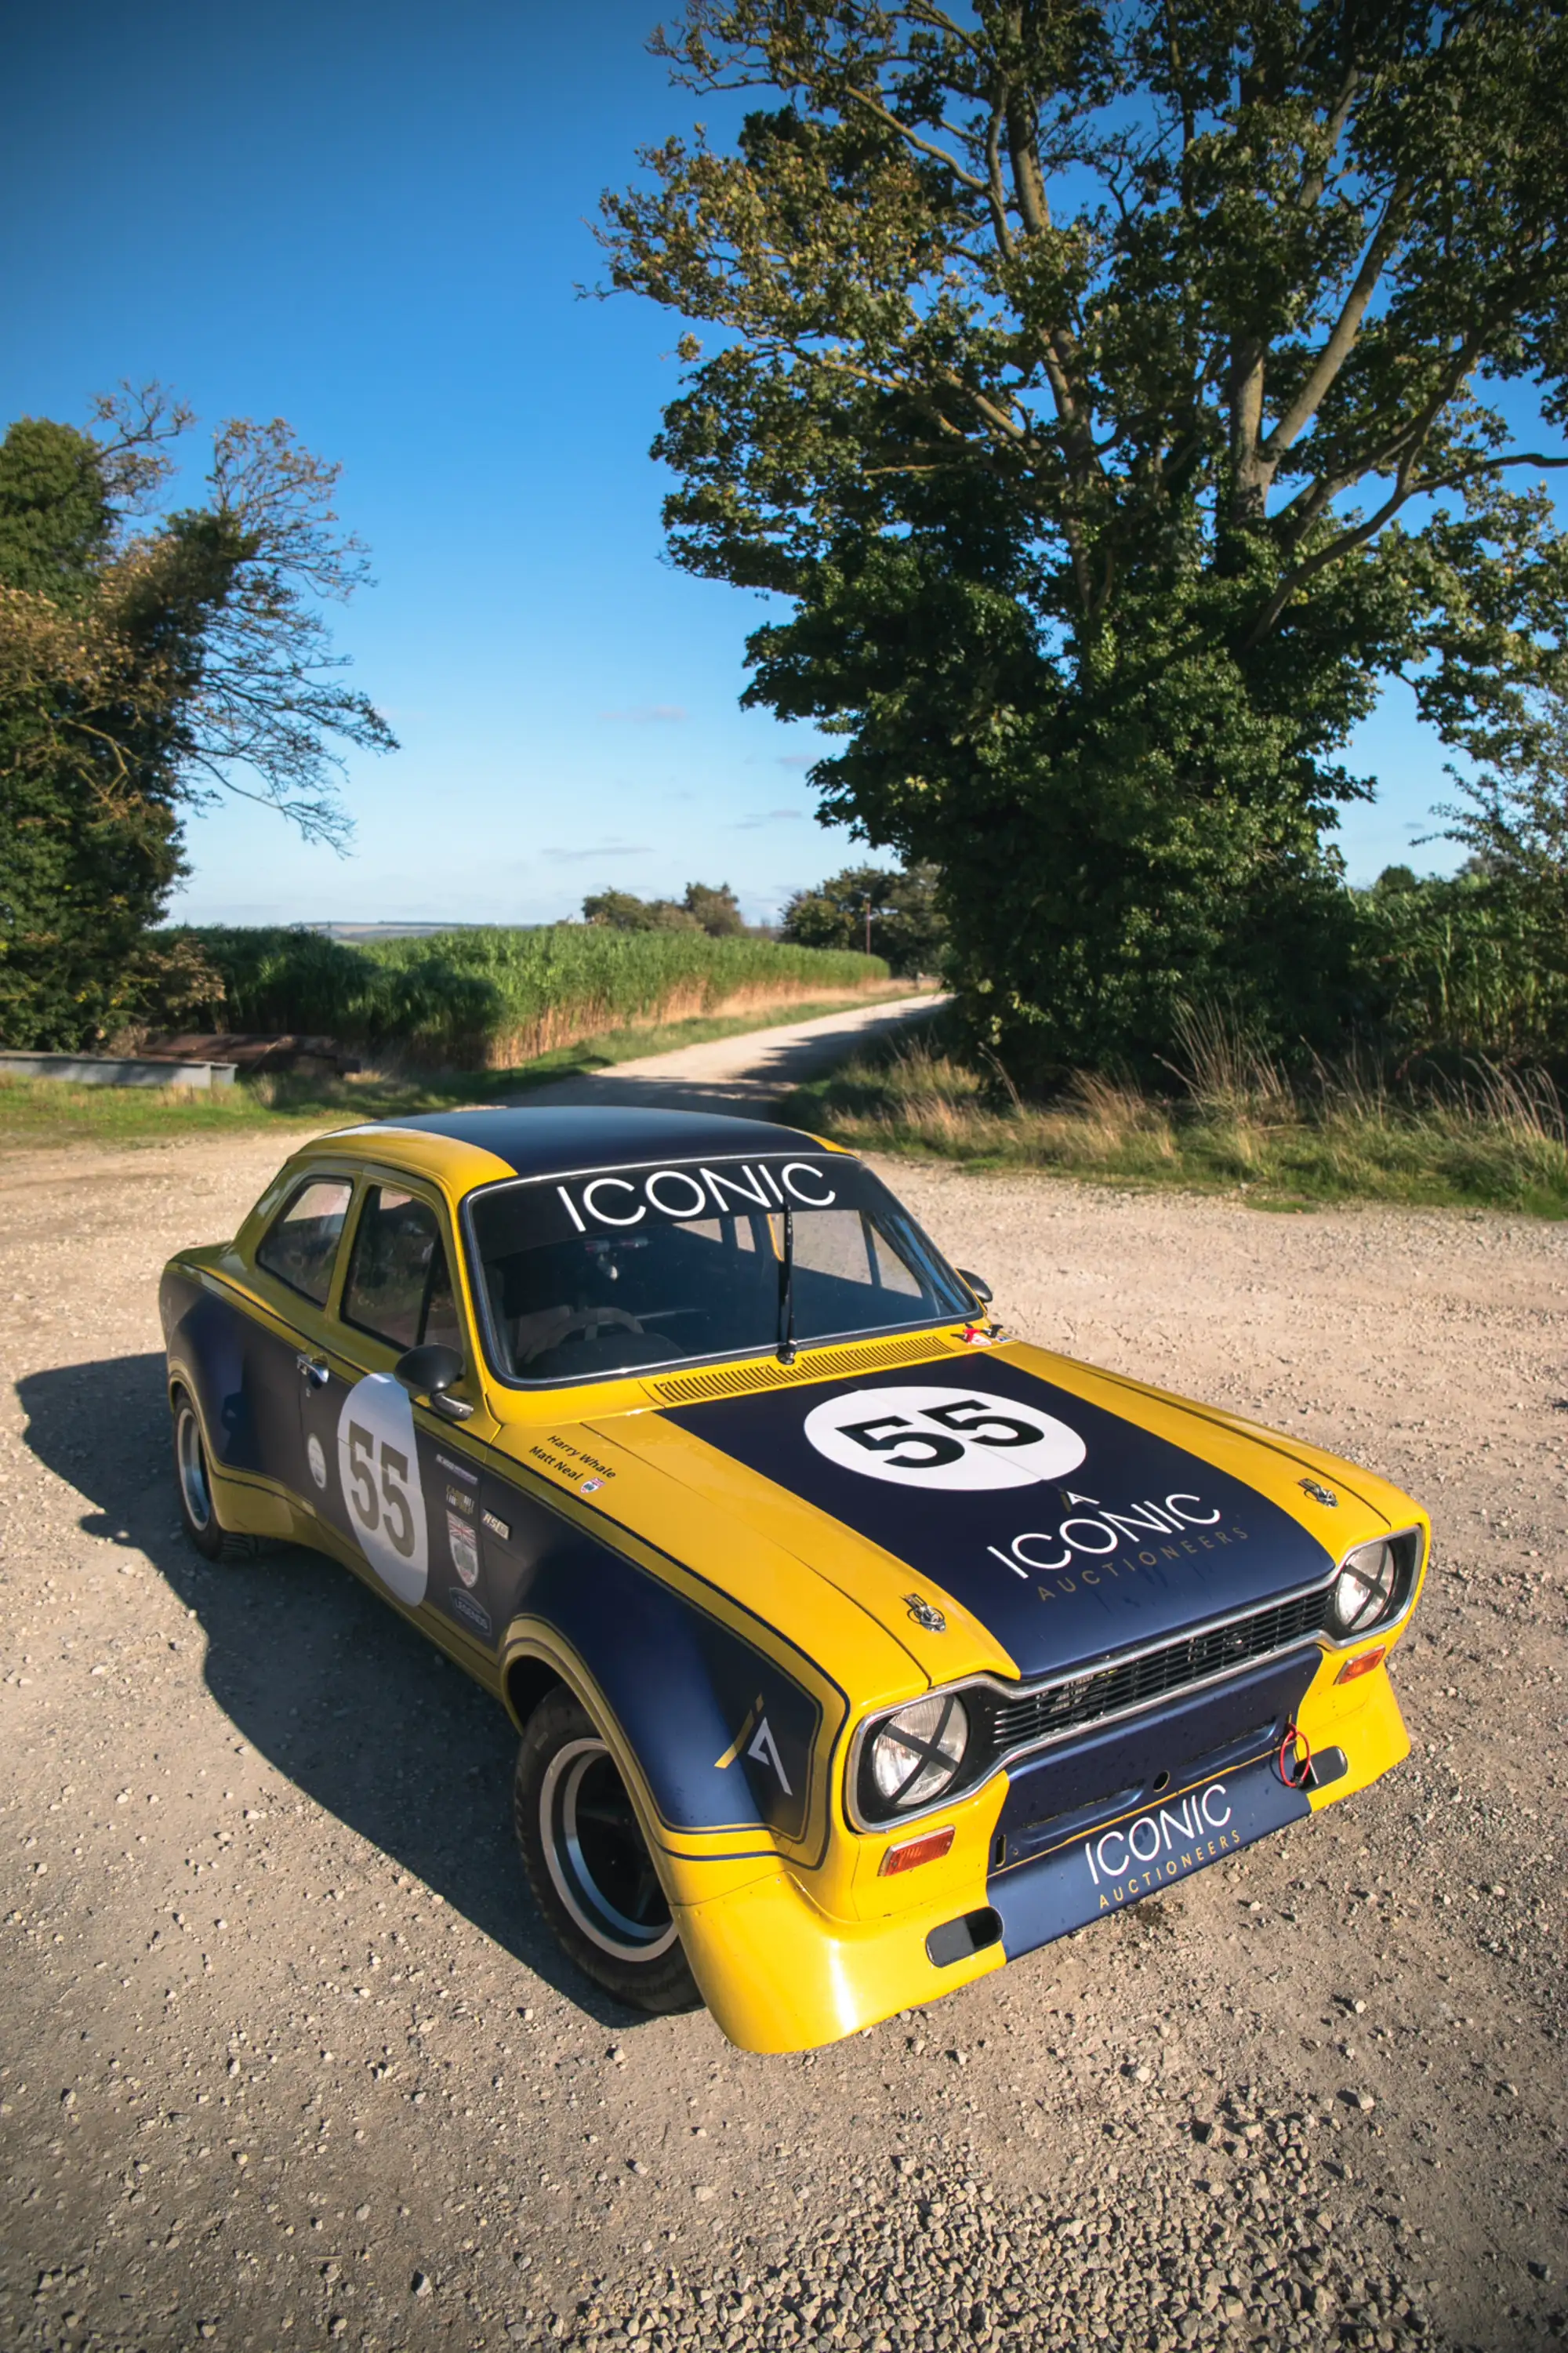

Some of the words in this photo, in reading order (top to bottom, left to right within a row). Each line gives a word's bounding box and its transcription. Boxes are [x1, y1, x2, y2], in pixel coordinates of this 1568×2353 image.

[557, 1162, 836, 1232] ICONIC
[529, 1446, 556, 1465] Matt
[554, 1461, 583, 1480] Neal
[547, 1435, 580, 1456] Harry
[579, 1454, 616, 1478] Whale
[835, 1399, 1045, 1469] 55
[349, 1420, 415, 1557] 55
[987, 1494, 1220, 1578] ICONIC
[1038, 1527, 1248, 1601] AUCTIONEERS
[1085, 1785, 1231, 1884] ICONIC
[1098, 1829, 1241, 1909] AUCTIONEERS
